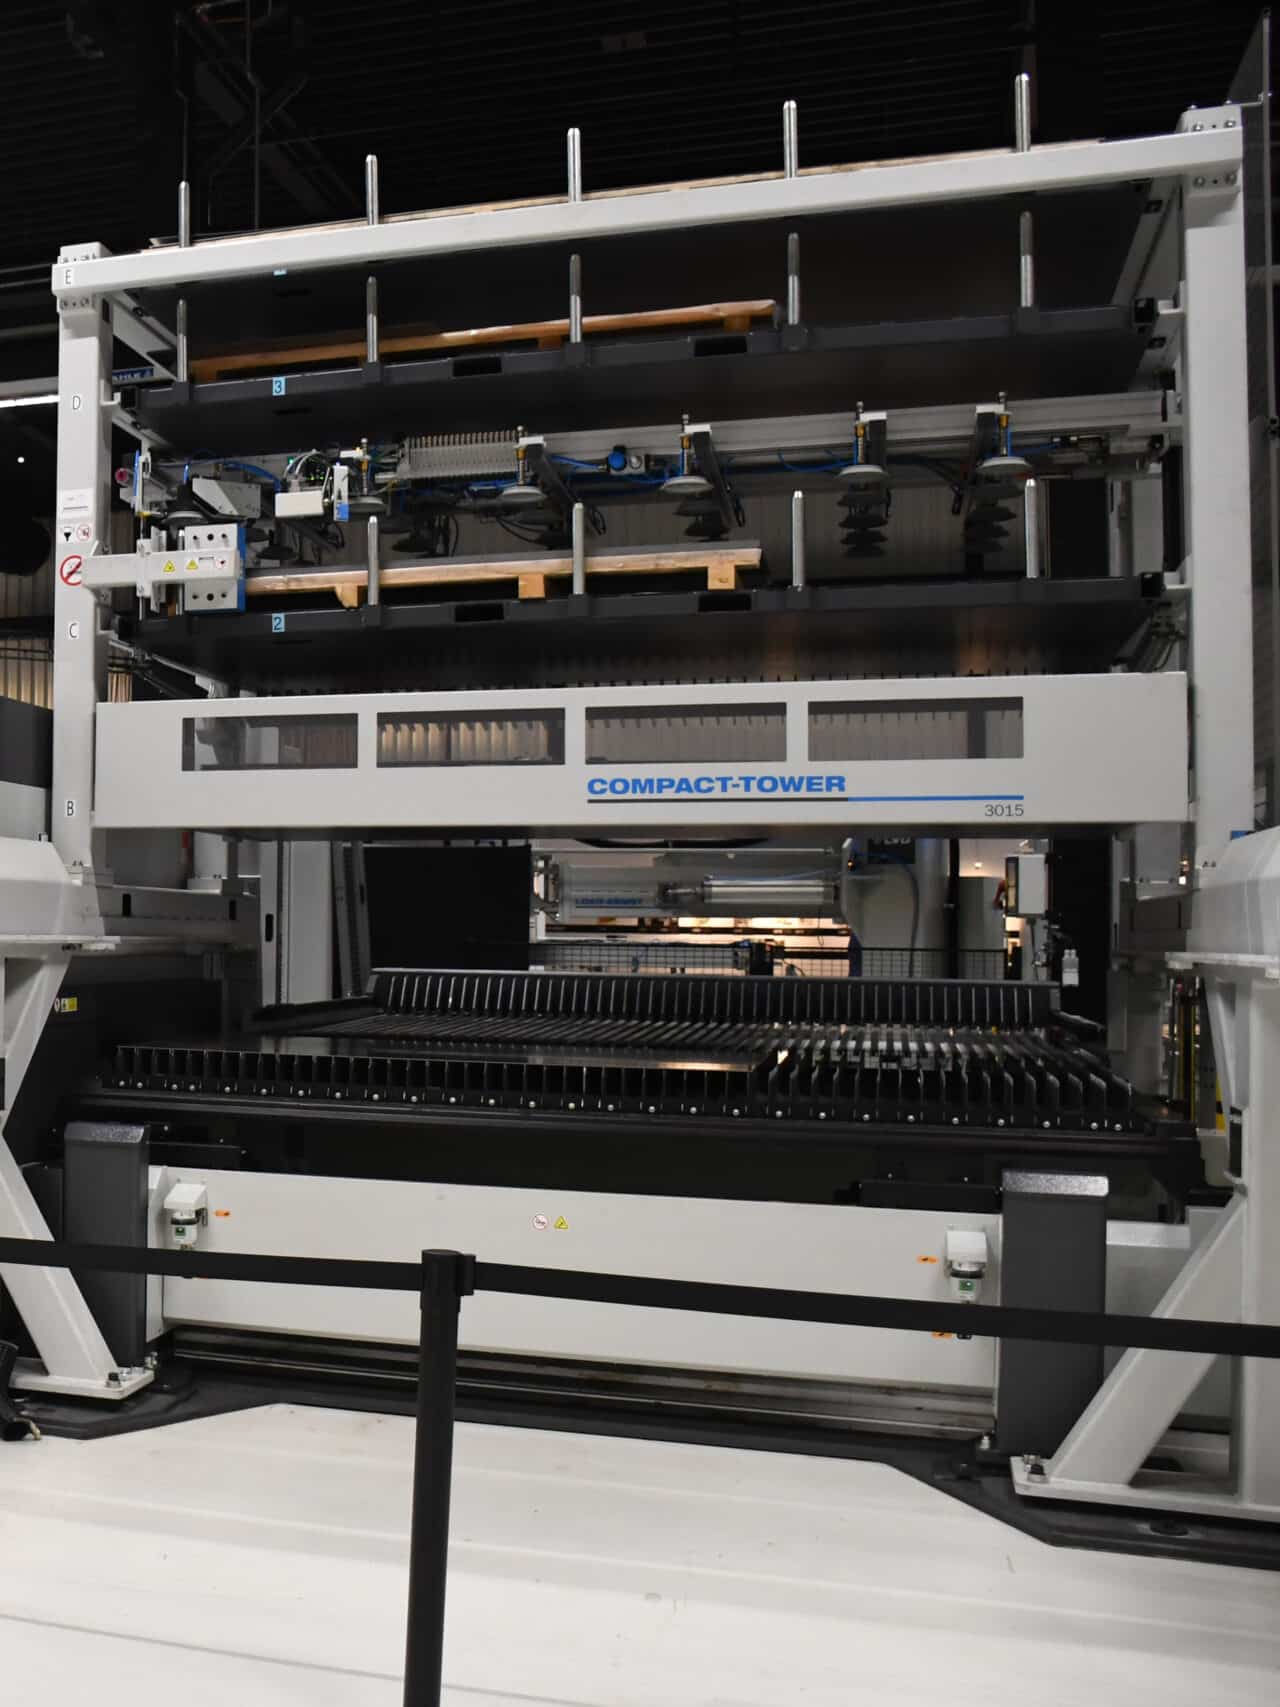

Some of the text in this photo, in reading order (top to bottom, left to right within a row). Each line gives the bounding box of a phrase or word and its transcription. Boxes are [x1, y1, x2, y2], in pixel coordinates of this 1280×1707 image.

[65, 269, 72, 285] E
[274, 380, 283, 394] 3
[72, 395, 81, 410] D
[69, 622, 77, 638] C
[273, 616, 282, 631] 2
[587, 775, 846, 795] COMPACT-TOWER
[67, 800, 74, 816] B
[984, 803, 1025, 817] 3015
